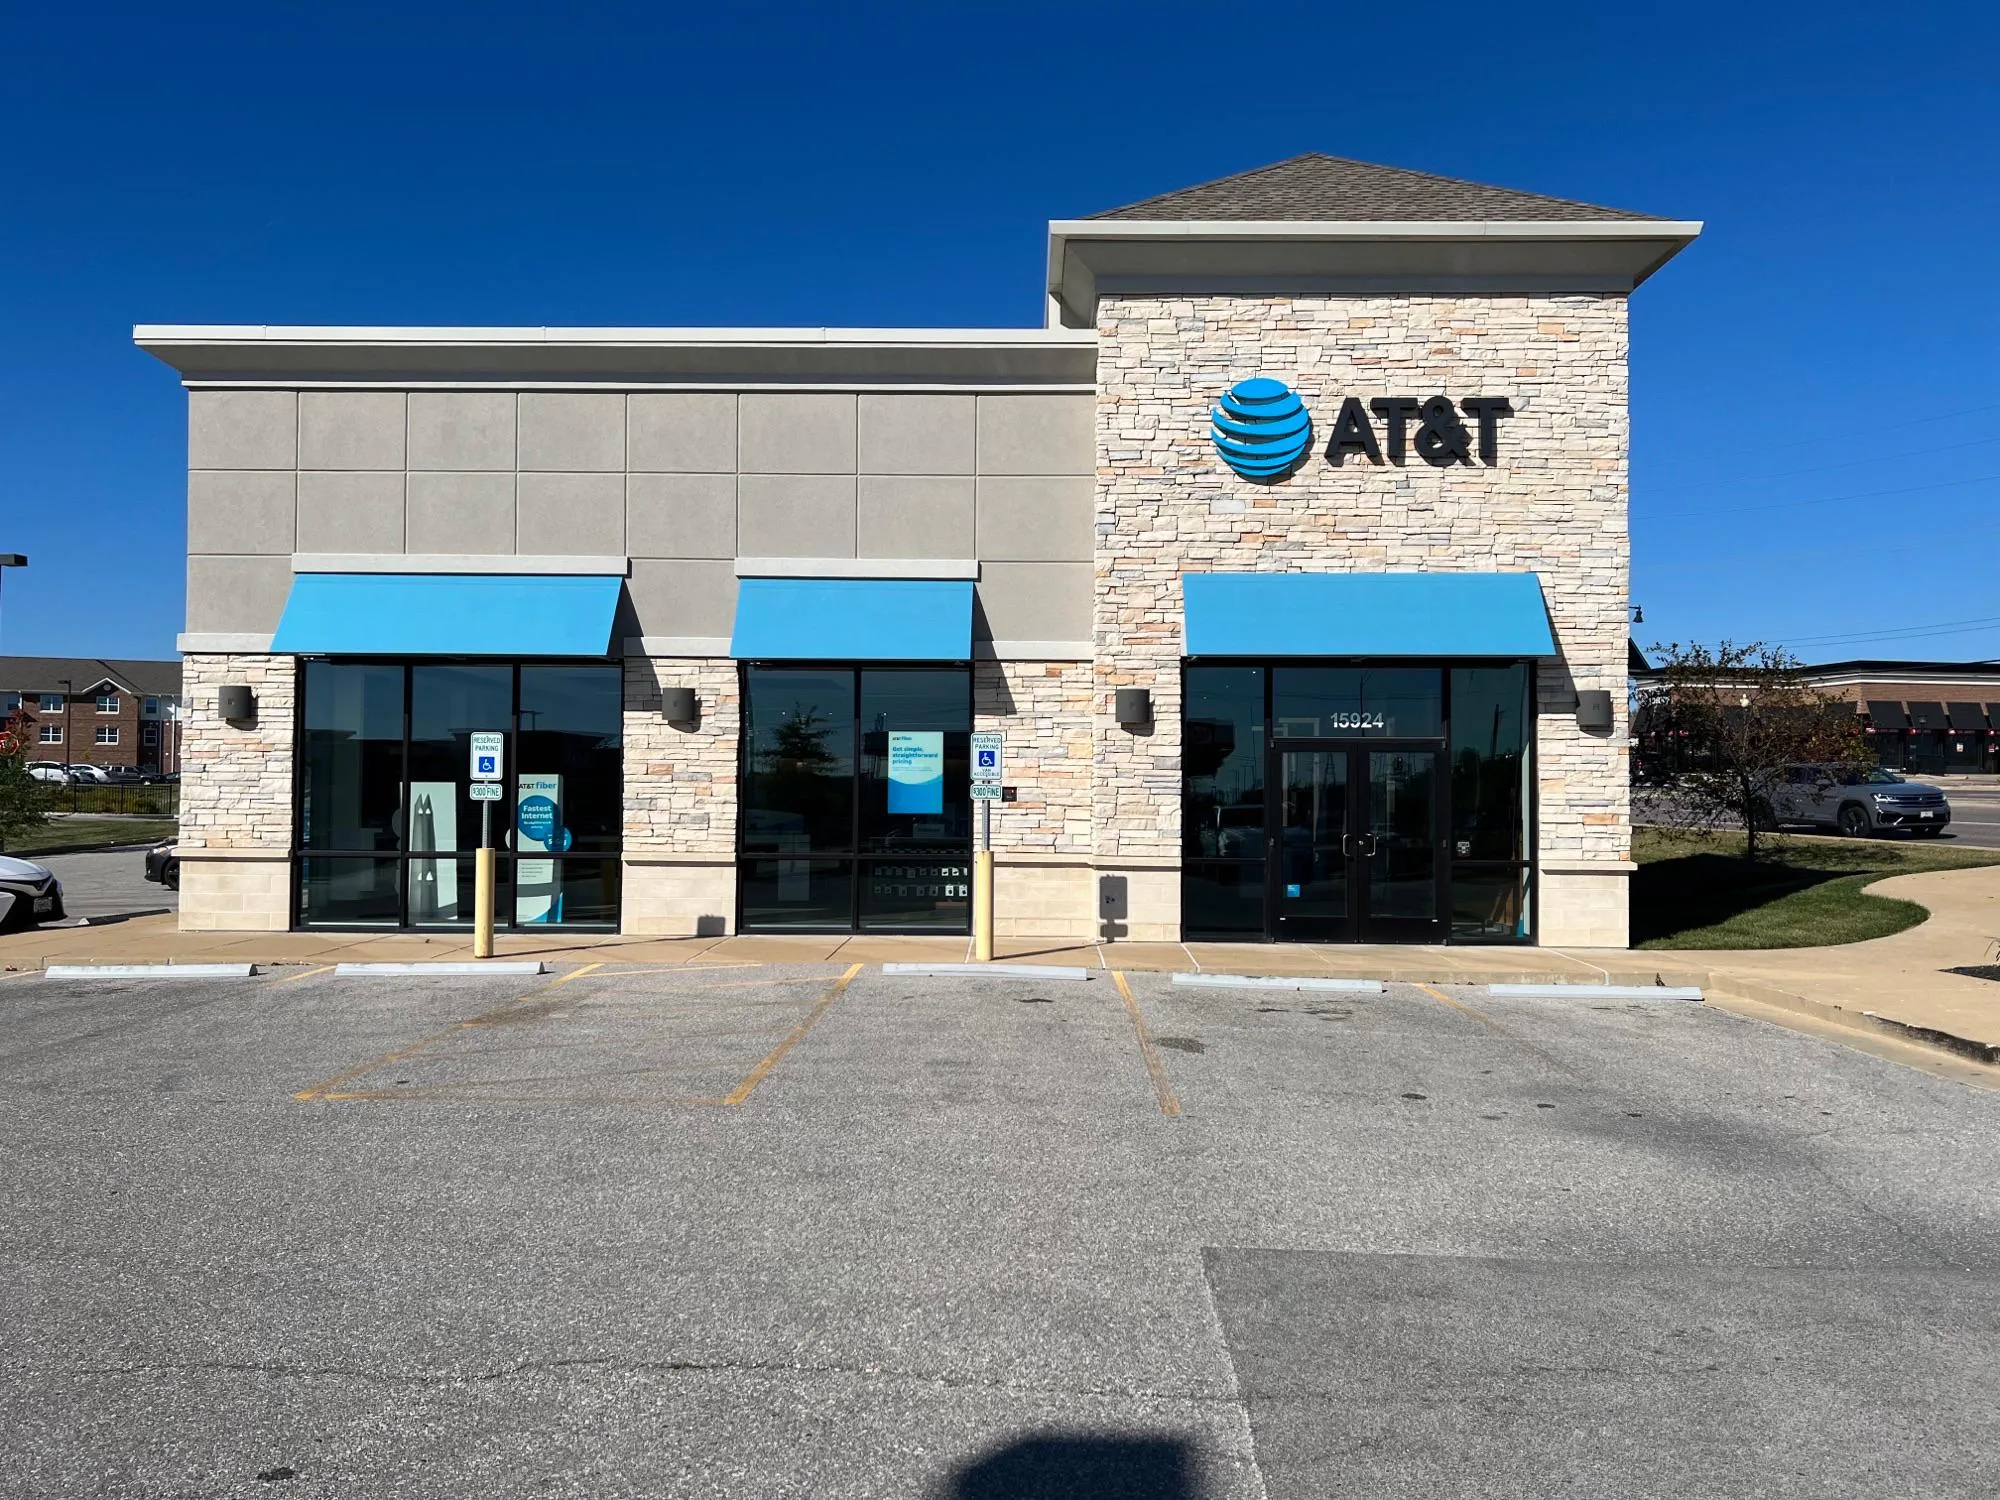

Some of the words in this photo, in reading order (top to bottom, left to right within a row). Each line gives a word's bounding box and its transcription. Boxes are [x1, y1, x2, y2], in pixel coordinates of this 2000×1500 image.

[1324, 395, 1510, 464] AT&T
[1330, 712, 1385, 728] 15924
[536, 781, 557, 790] fiber
[472, 787, 486, 797] $300
[487, 787, 500, 797] FINE
[973, 787, 986, 797] $300
[987, 787, 1000, 797] FINE
